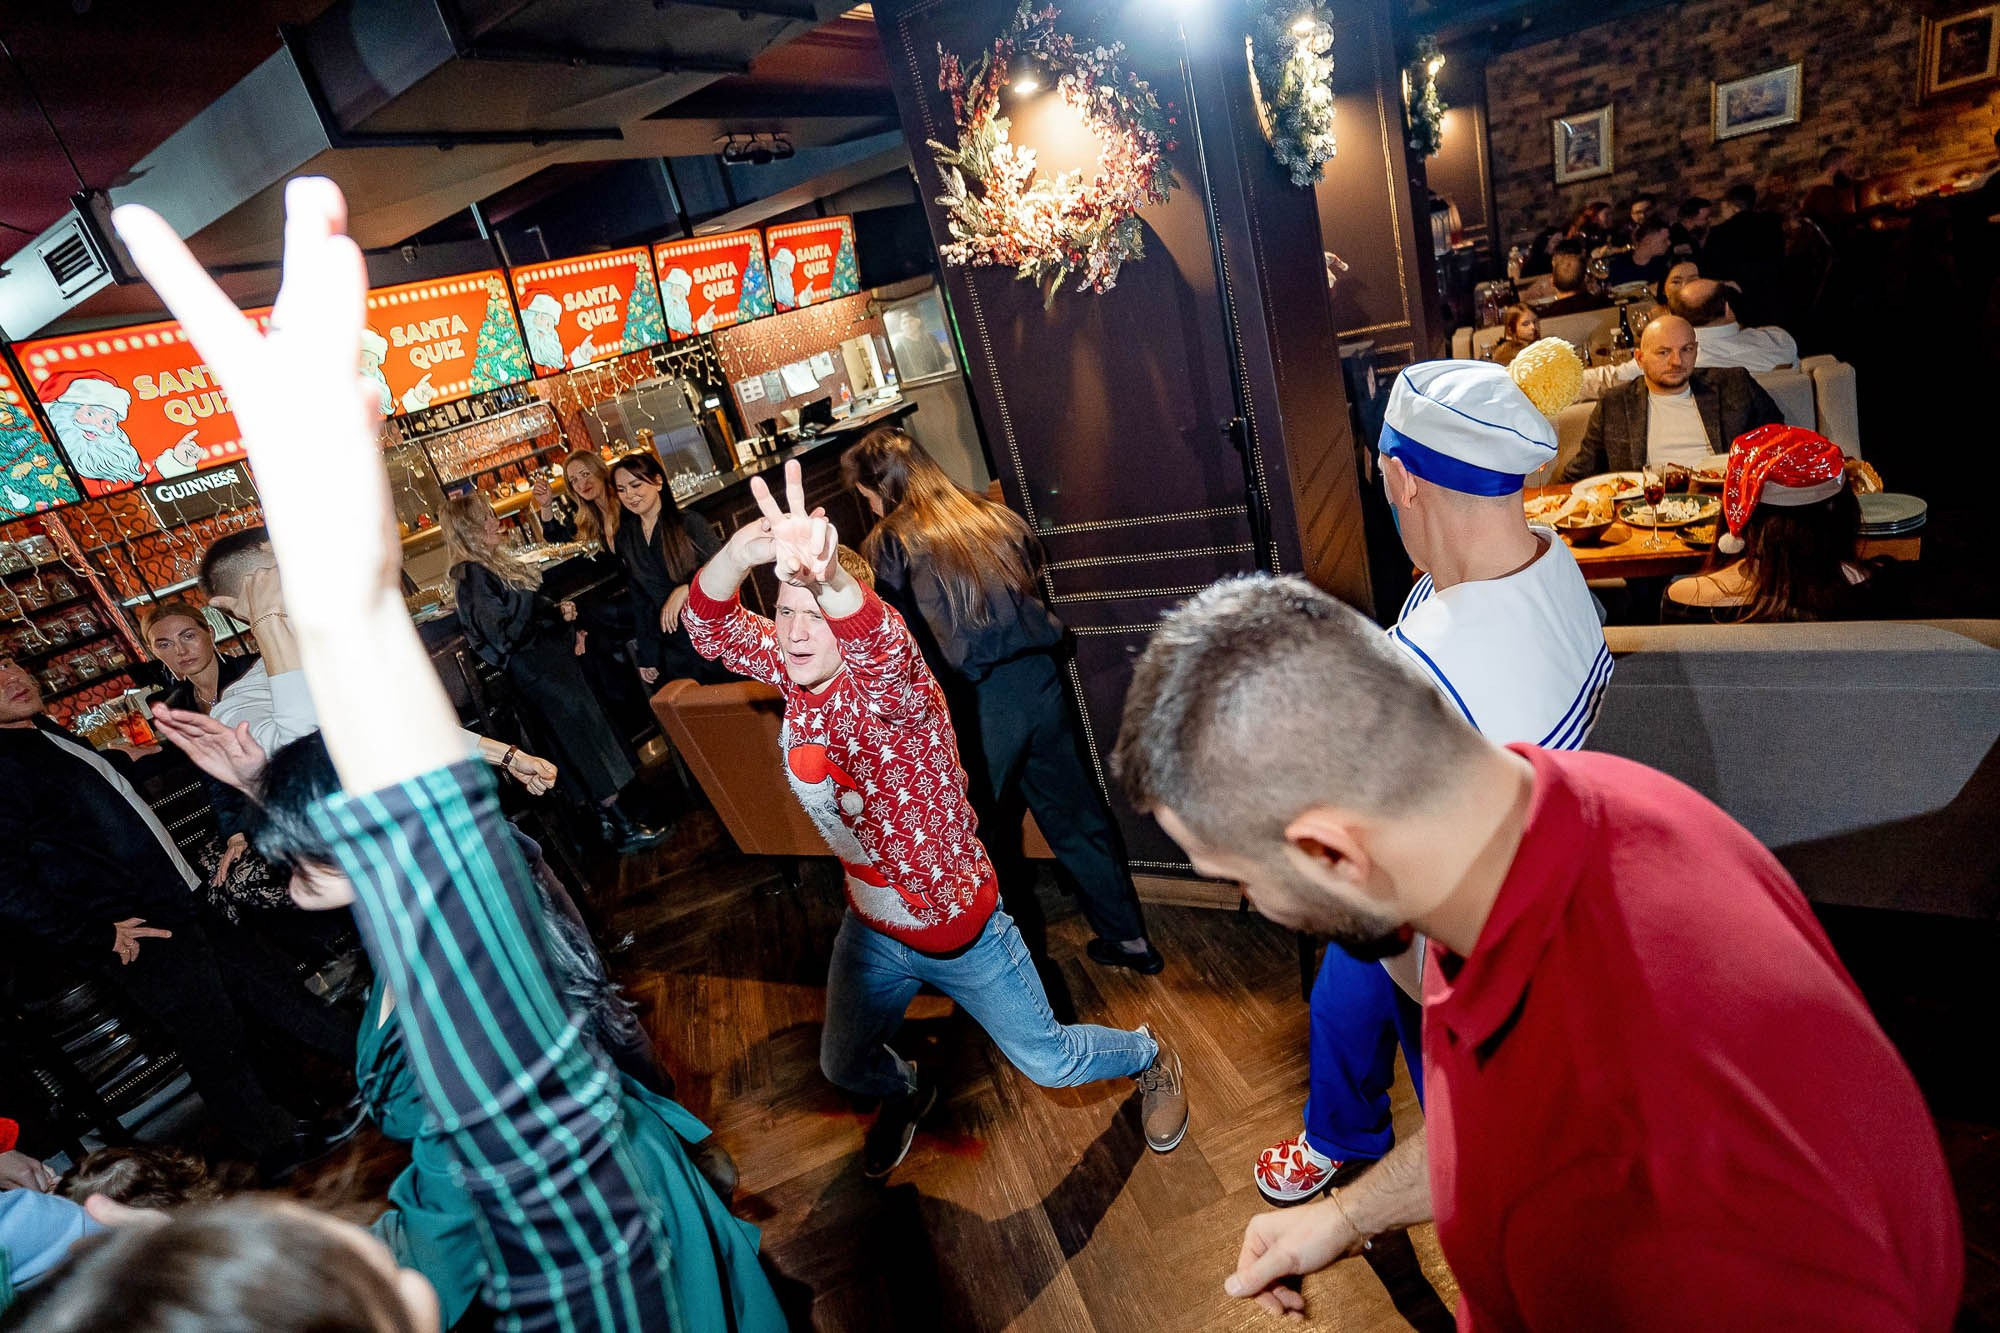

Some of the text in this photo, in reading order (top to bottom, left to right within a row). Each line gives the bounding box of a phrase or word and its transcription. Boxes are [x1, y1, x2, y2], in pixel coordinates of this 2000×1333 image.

[796, 244, 832, 262] SANTA
[692, 261, 738, 284] SANTA
[803, 260, 829, 279] QUIZ
[563, 284, 622, 311] SANTA
[702, 279, 735, 302] QUIZ
[390, 314, 469, 347] SANTA
[577, 304, 618, 331] QUIZ
[409, 338, 465, 369] QUIZ
[133, 364, 222, 400] SANT
[155, 468, 239, 502] GUINNESS
